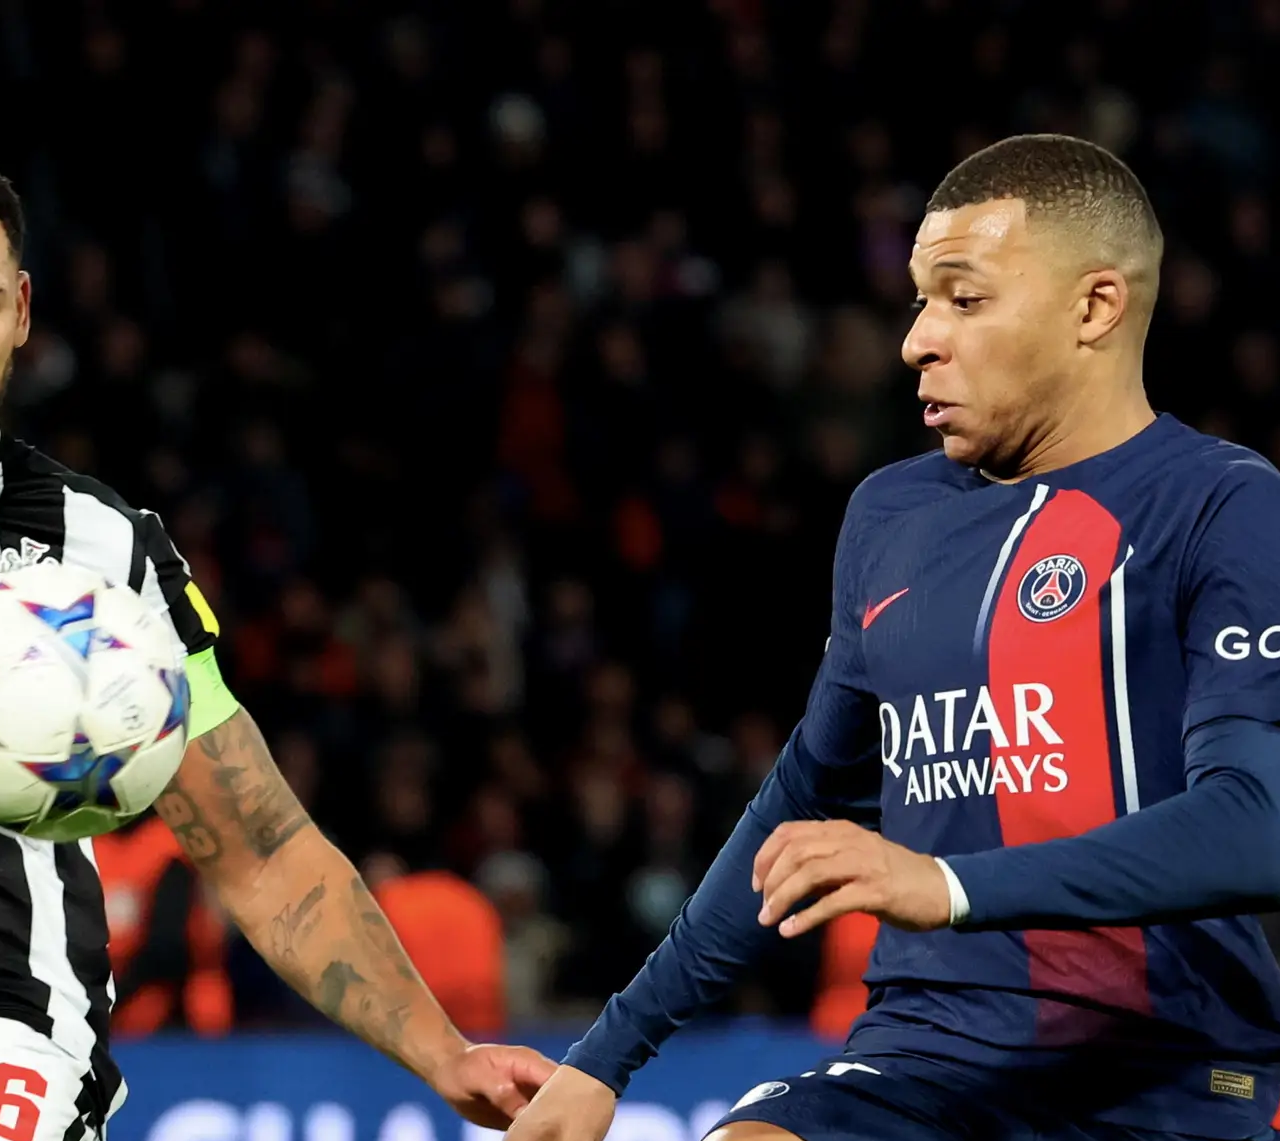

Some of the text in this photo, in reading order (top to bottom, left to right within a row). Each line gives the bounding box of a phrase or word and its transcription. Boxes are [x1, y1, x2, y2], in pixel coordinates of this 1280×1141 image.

[1035, 558, 1078, 576] PARIS
[878, 682, 1065, 779] QATAR
[904, 752, 1069, 806] AIRWAYS
